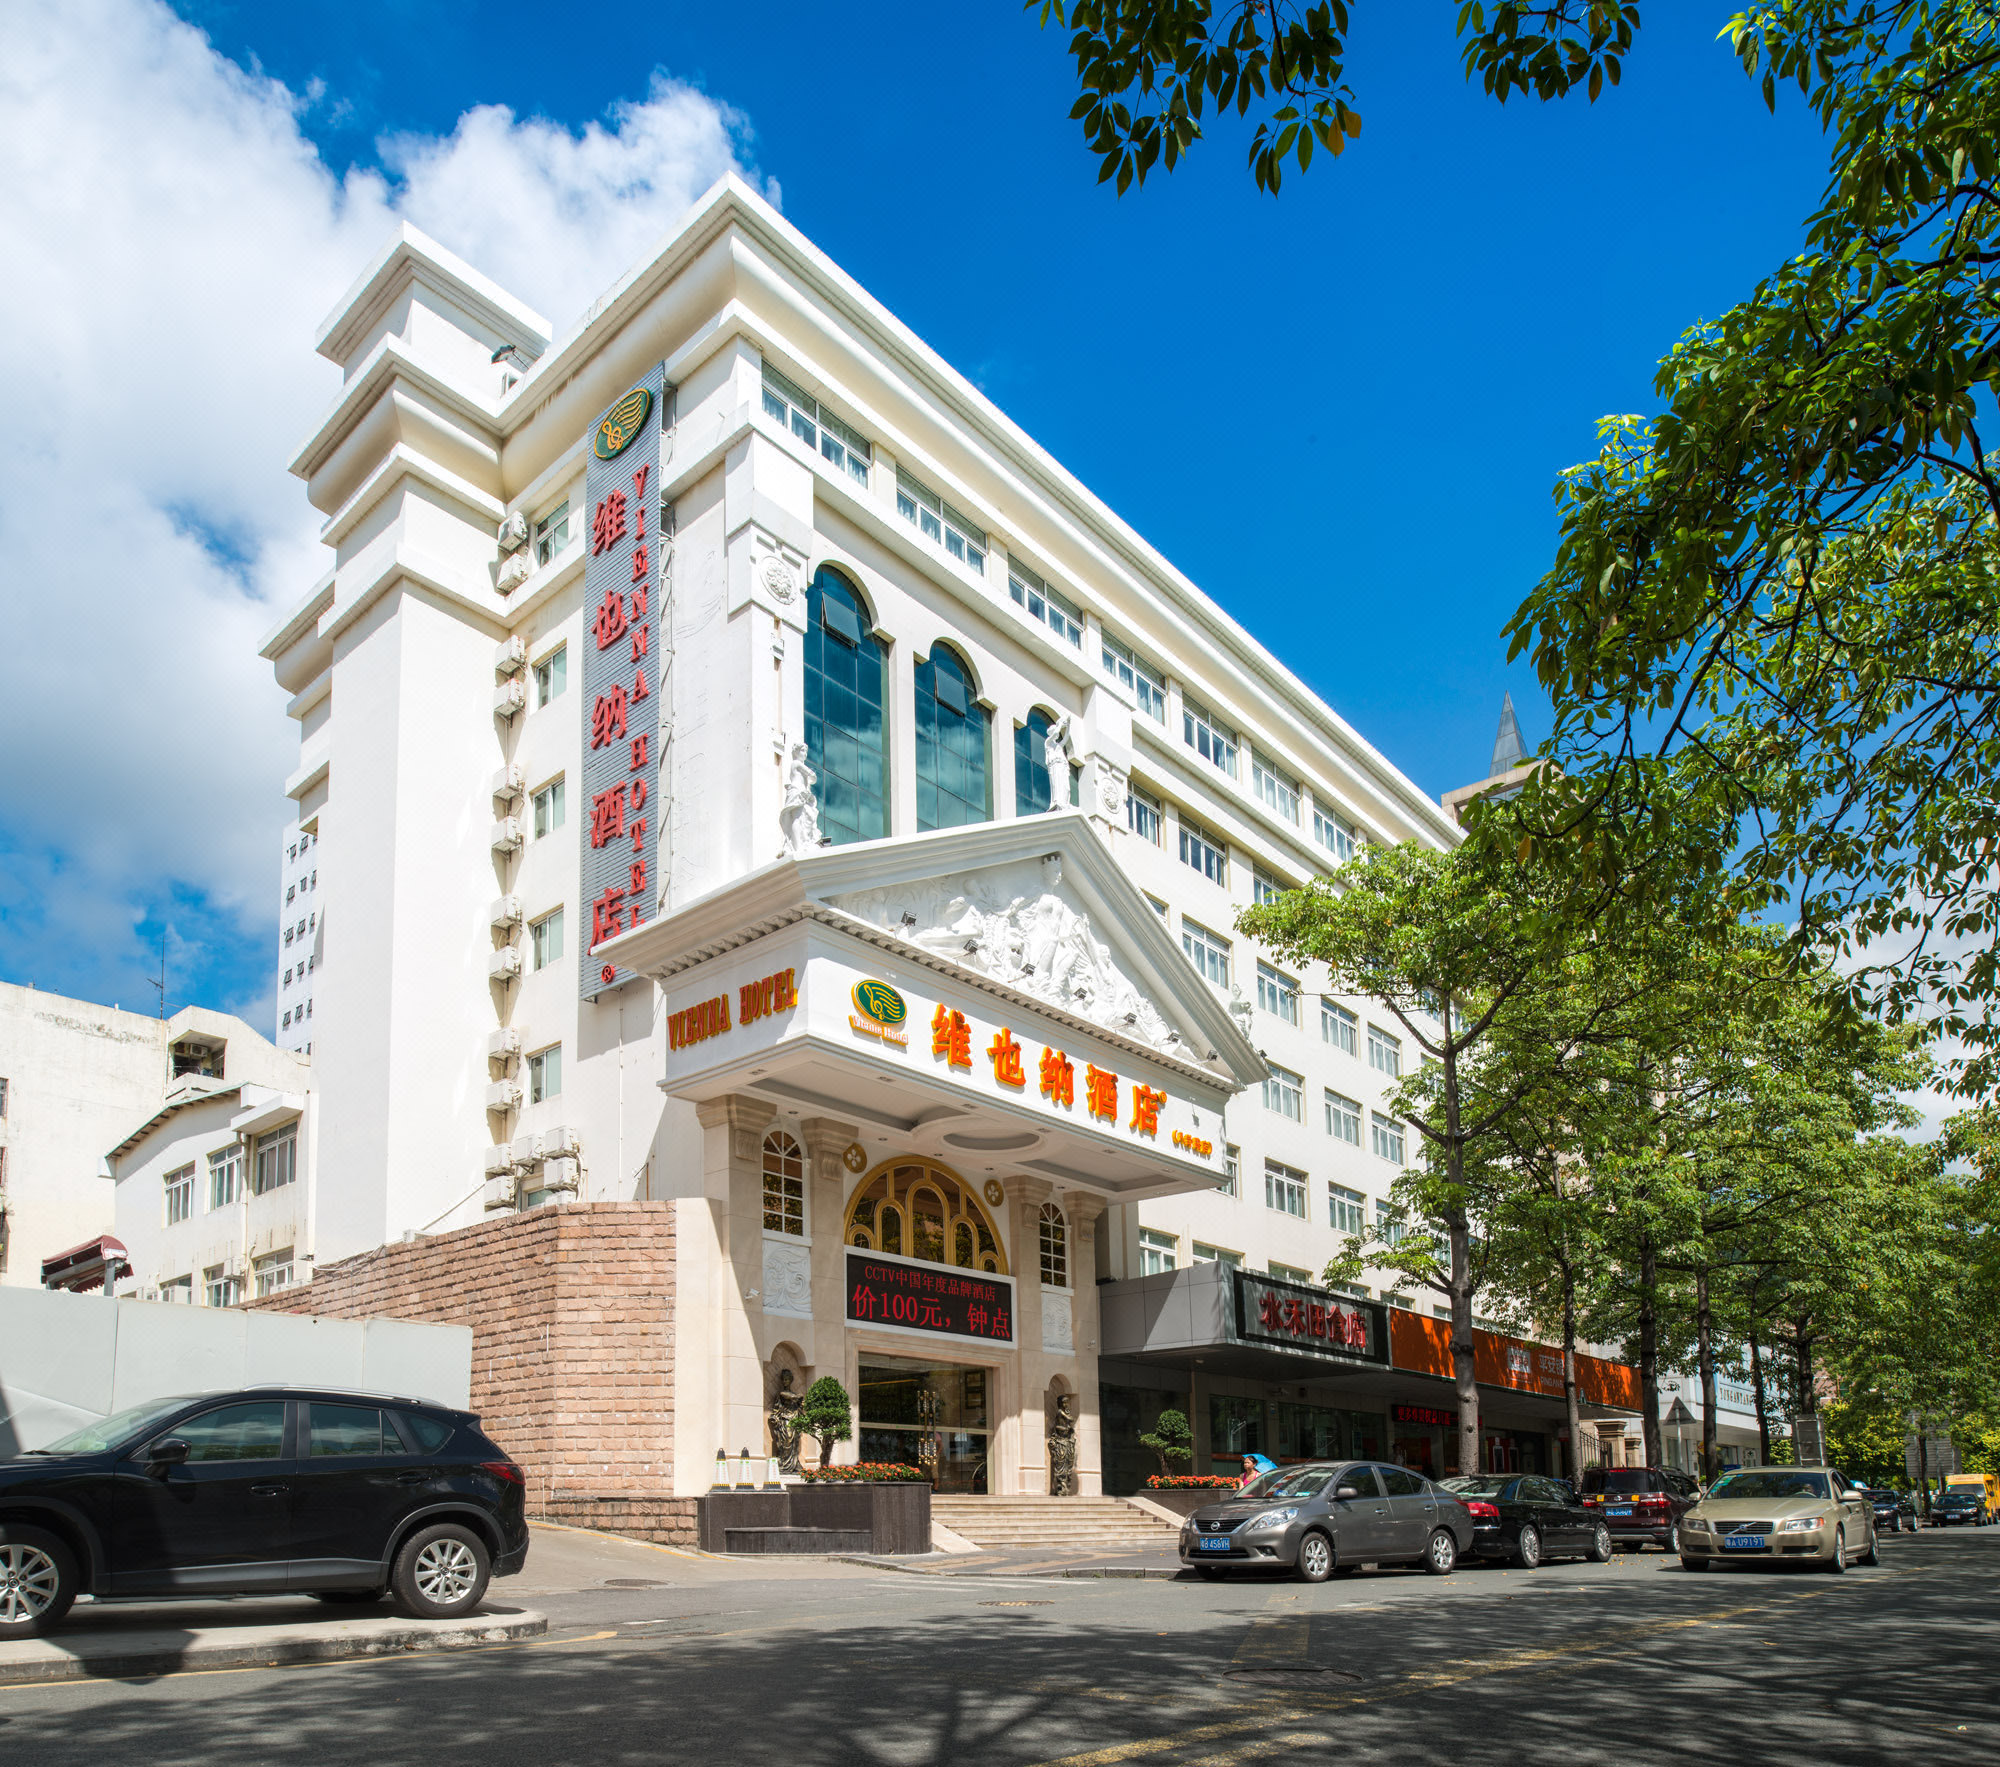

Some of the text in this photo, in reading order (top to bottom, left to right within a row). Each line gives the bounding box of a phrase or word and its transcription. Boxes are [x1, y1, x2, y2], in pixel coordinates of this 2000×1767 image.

[630, 463, 651, 704] VIENNA
[589, 488, 627, 956] 维也纳酒店
[667, 967, 798, 1052] VIENNA HOTEL
[848, 1015, 883, 1037] Vienna
[930, 1003, 1161, 1137] 维也纳酒店
[863, 1265, 996, 1303] CCTV中国年度品牌酒店
[1258, 1291, 1367, 1349] 水禾田食府
[1538, 1354, 1565, 1376] 平安银
